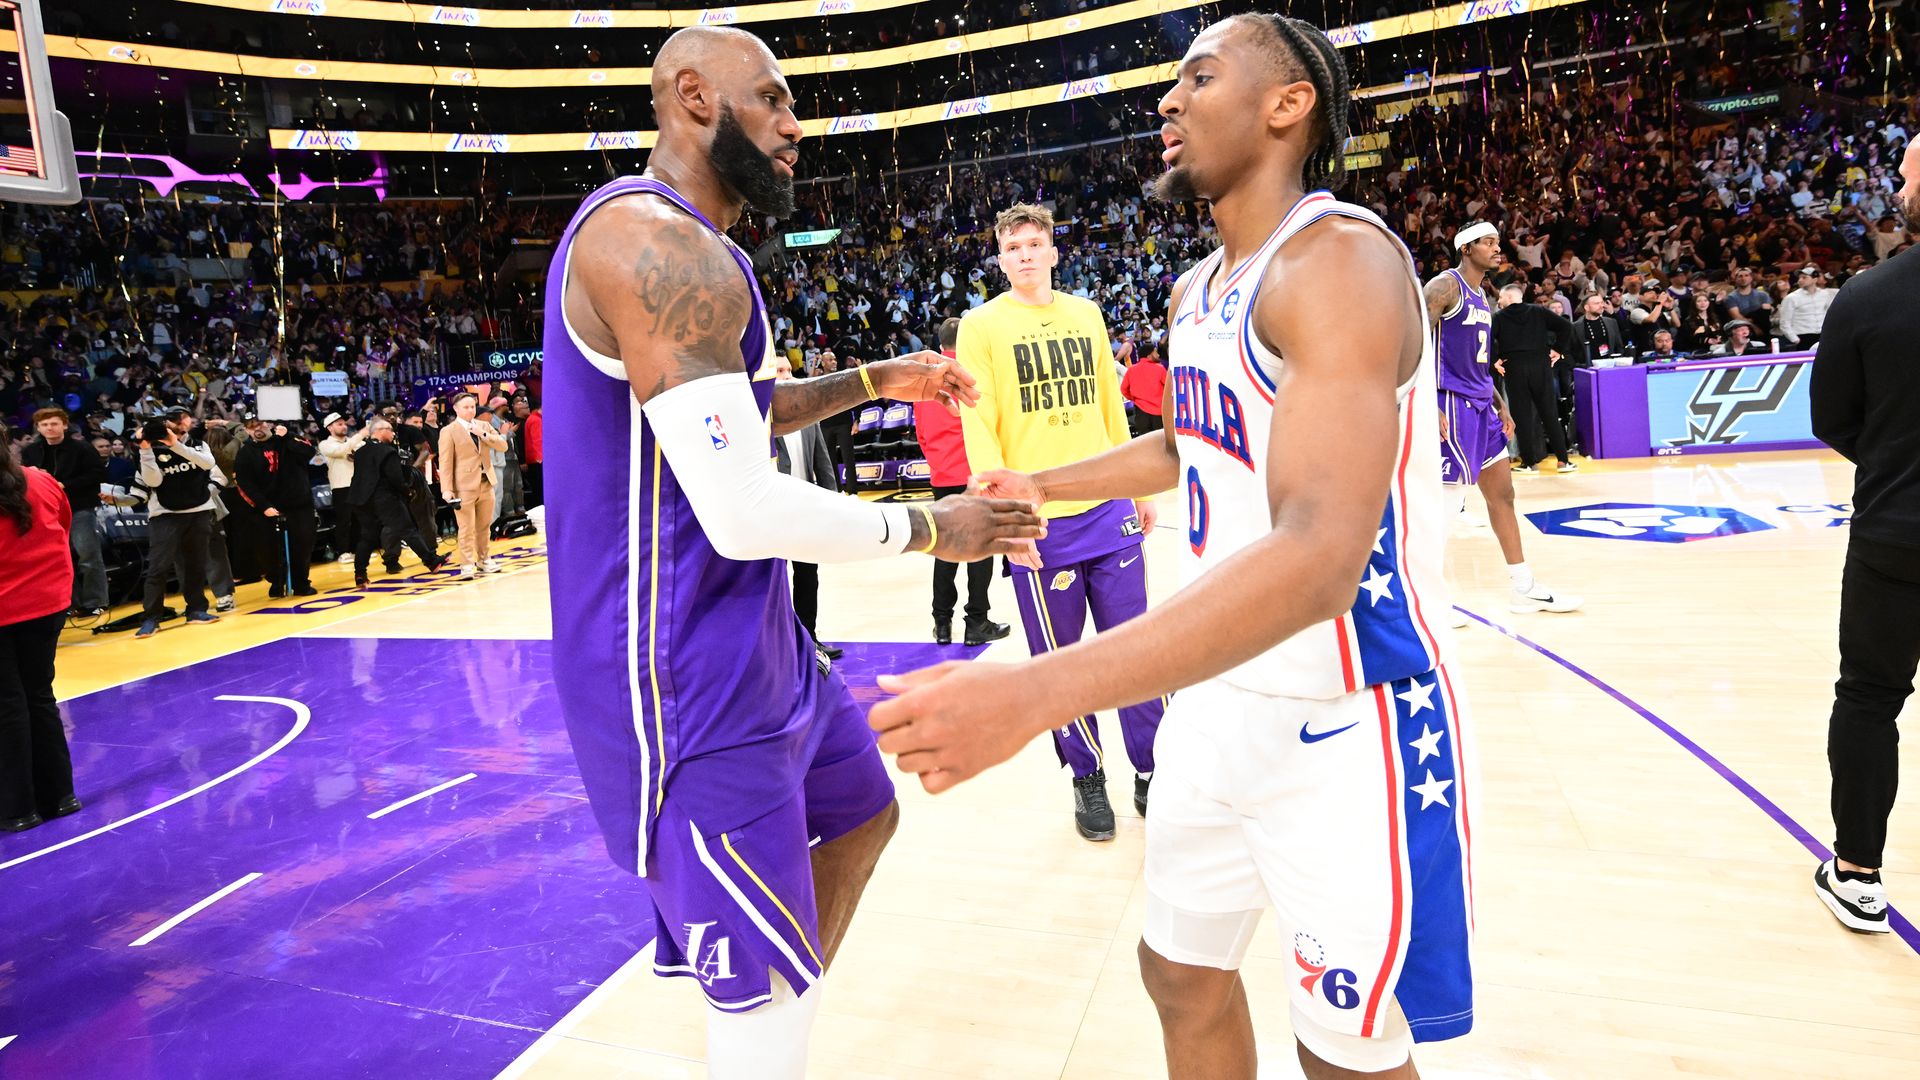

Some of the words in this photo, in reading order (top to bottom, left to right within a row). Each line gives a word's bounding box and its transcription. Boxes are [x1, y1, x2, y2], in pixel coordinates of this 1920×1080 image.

[1708, 94, 1779, 111] crypto.com
[1022, 331, 1057, 340] BUILT
[1476, 330, 1488, 363] 2
[428, 376, 447, 386] 17x
[448, 369, 519, 386] CHAMPIONS
[1013, 337, 1095, 385] BLACK
[1020, 378, 1095, 413] HISTORY
[1173, 366, 1256, 474] HILA
[682, 921, 738, 987] LA
[1295, 946, 1361, 1010] 76
